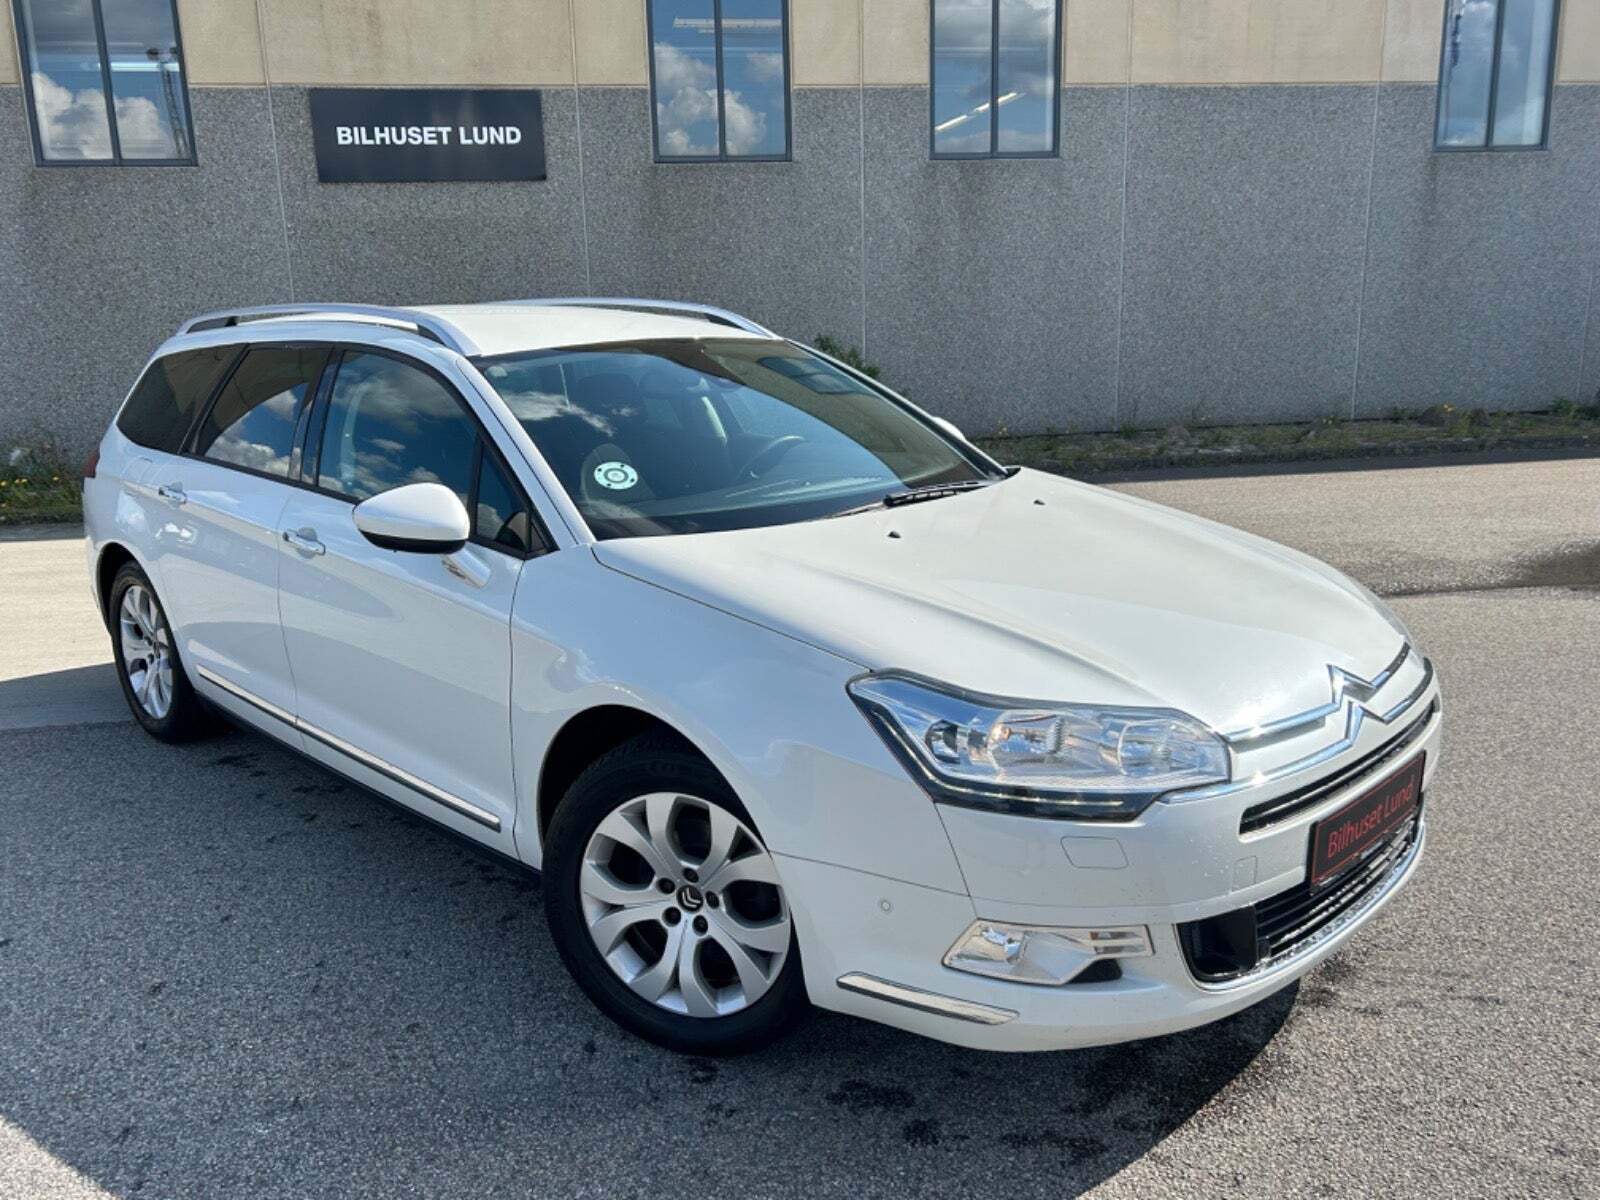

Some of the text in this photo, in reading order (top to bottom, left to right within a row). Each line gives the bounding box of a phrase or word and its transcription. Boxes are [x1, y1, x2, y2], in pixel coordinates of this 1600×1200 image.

[336, 126, 522, 145] BILHUSET LUND
[1327, 775, 1415, 858] Bilhuset Lund
